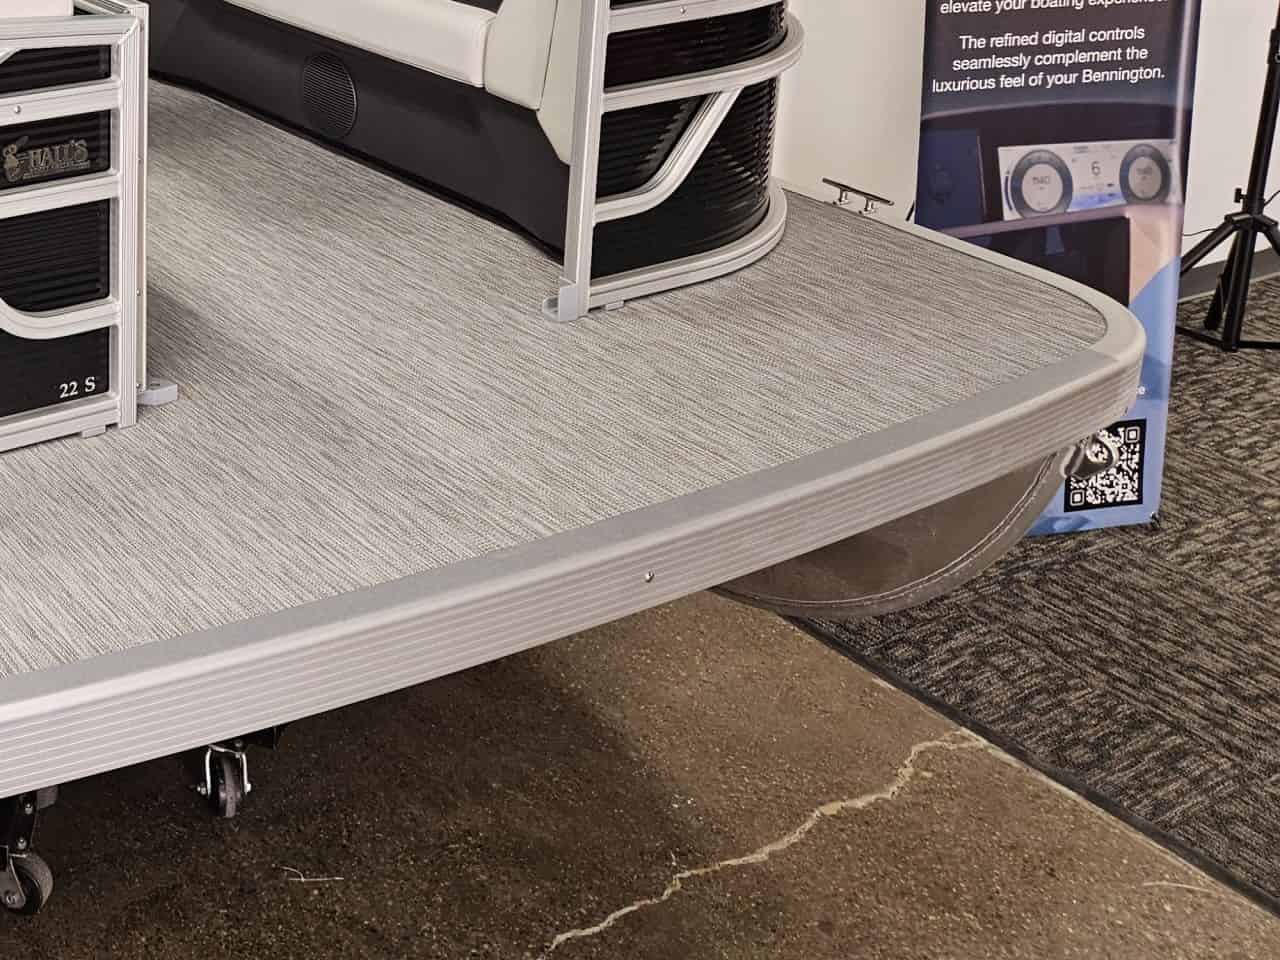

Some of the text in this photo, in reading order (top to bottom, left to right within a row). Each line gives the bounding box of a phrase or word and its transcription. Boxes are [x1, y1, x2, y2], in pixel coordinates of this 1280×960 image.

[960, 26, 1145, 50] The refined digital controls
[952, 46, 1148, 71] seamlessly complement the
[932, 66, 1166, 93] luxurious feel of your Bennington.
[60, 376, 96, 399] 22 S
